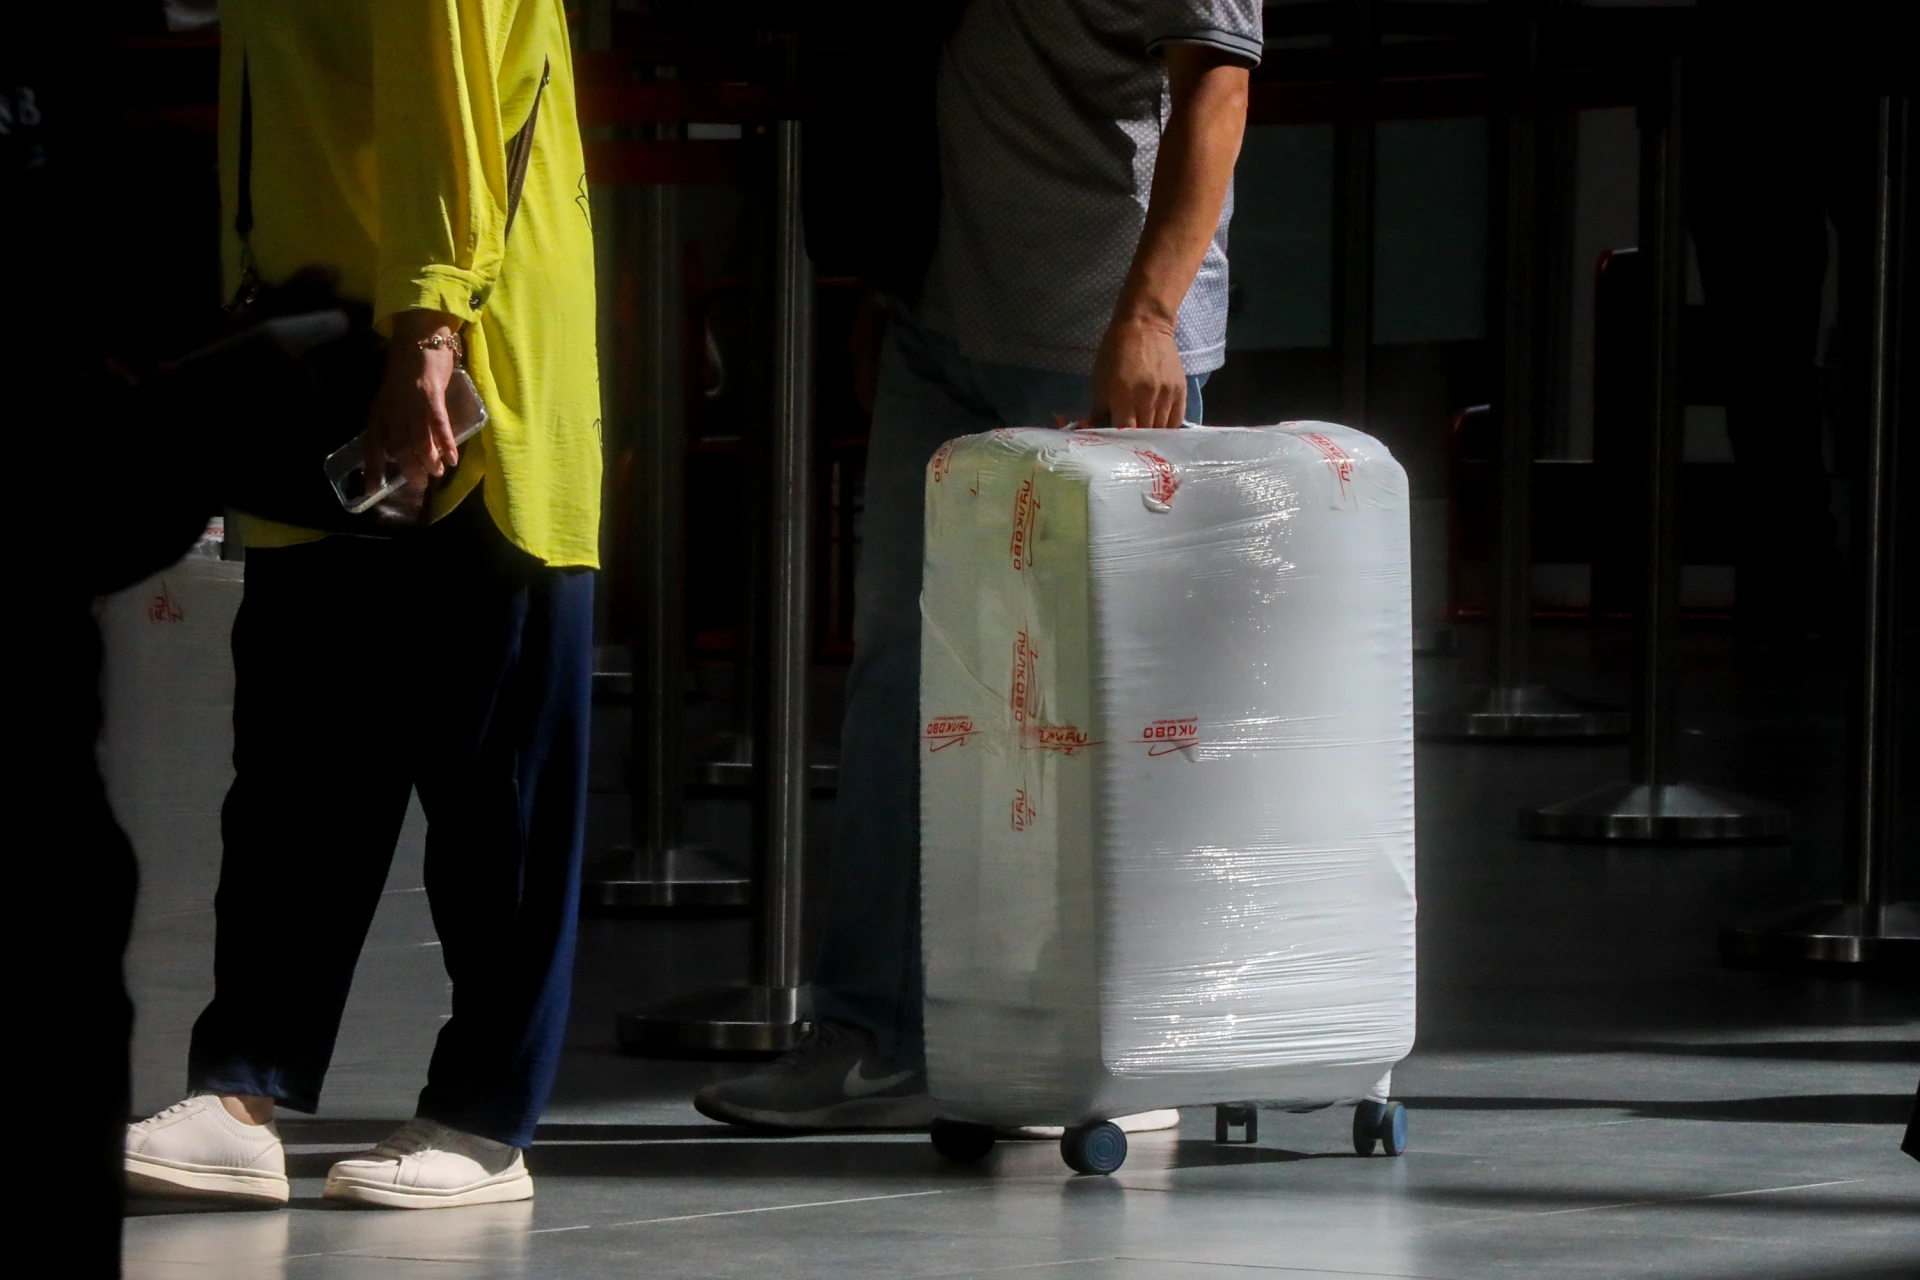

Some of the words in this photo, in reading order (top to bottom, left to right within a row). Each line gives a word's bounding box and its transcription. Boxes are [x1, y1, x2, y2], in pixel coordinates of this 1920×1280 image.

[1013, 480, 1032, 571] ПУЛКОВО
[1014, 630, 1026, 722] ПУЛКОВО
[926, 722, 973, 735] ПУЛКОВО
[1143, 725, 1197, 738] ЛКОВО
